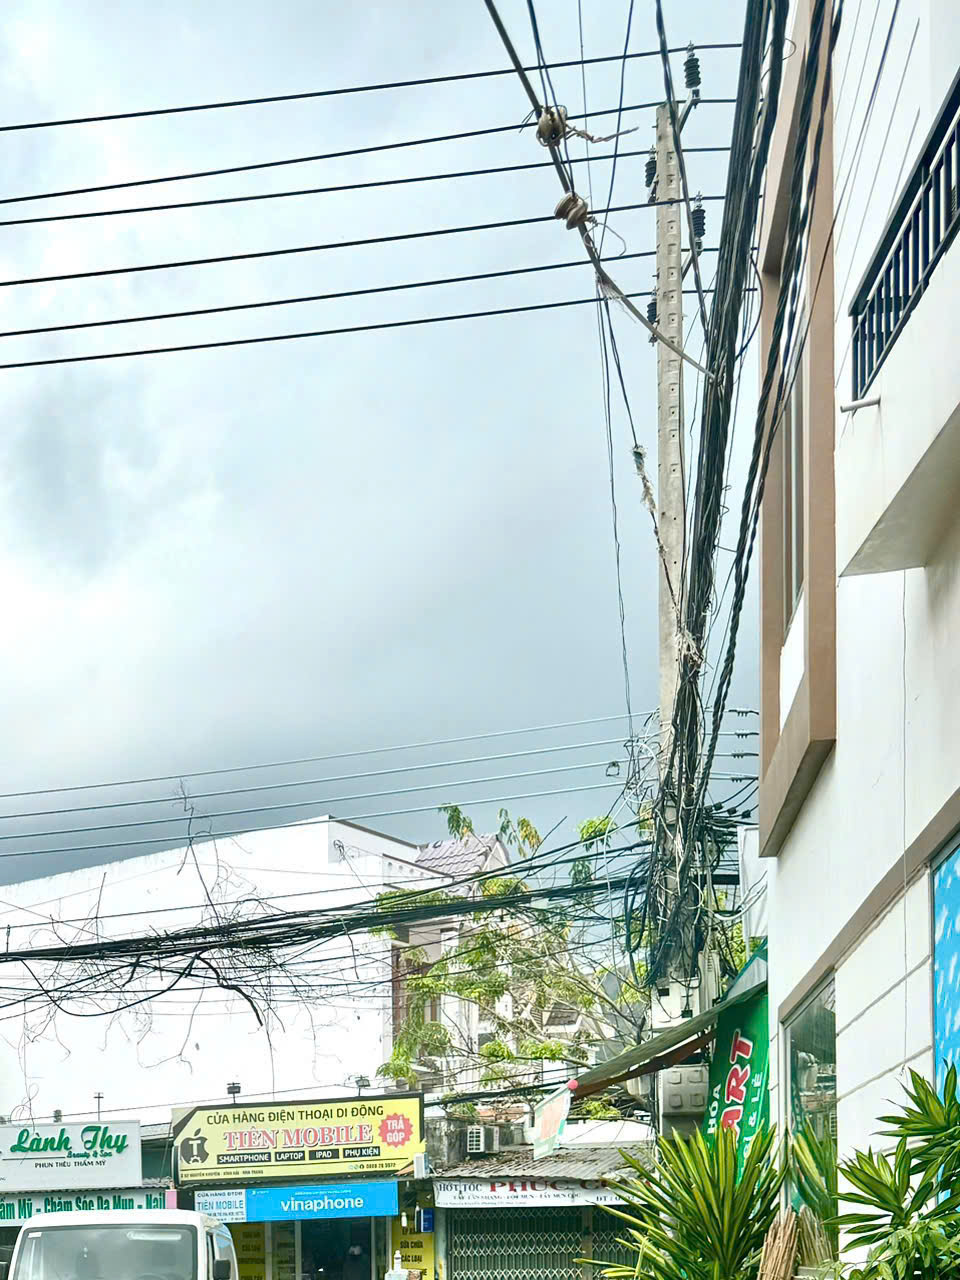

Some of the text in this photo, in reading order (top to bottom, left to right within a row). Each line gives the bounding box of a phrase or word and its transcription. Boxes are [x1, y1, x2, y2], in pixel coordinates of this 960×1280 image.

[207, 1104, 384, 1125] CỬA HÀNG ĐIỆN THOẠI DI ĐỘNG
[81, 1125, 129, 1154] Thy
[282, 1123, 374, 1149] MOBILE
[218, 1147, 379, 1163] SMARTPHONE LAPTOP IPAD PHỤ KIỆN
[97, 1197, 111, 1210] Da
[146, 1191, 166, 1209] Nail
[215, 1200, 244, 1210] MOBILE
[280, 1195, 364, 1212] vinaphone
